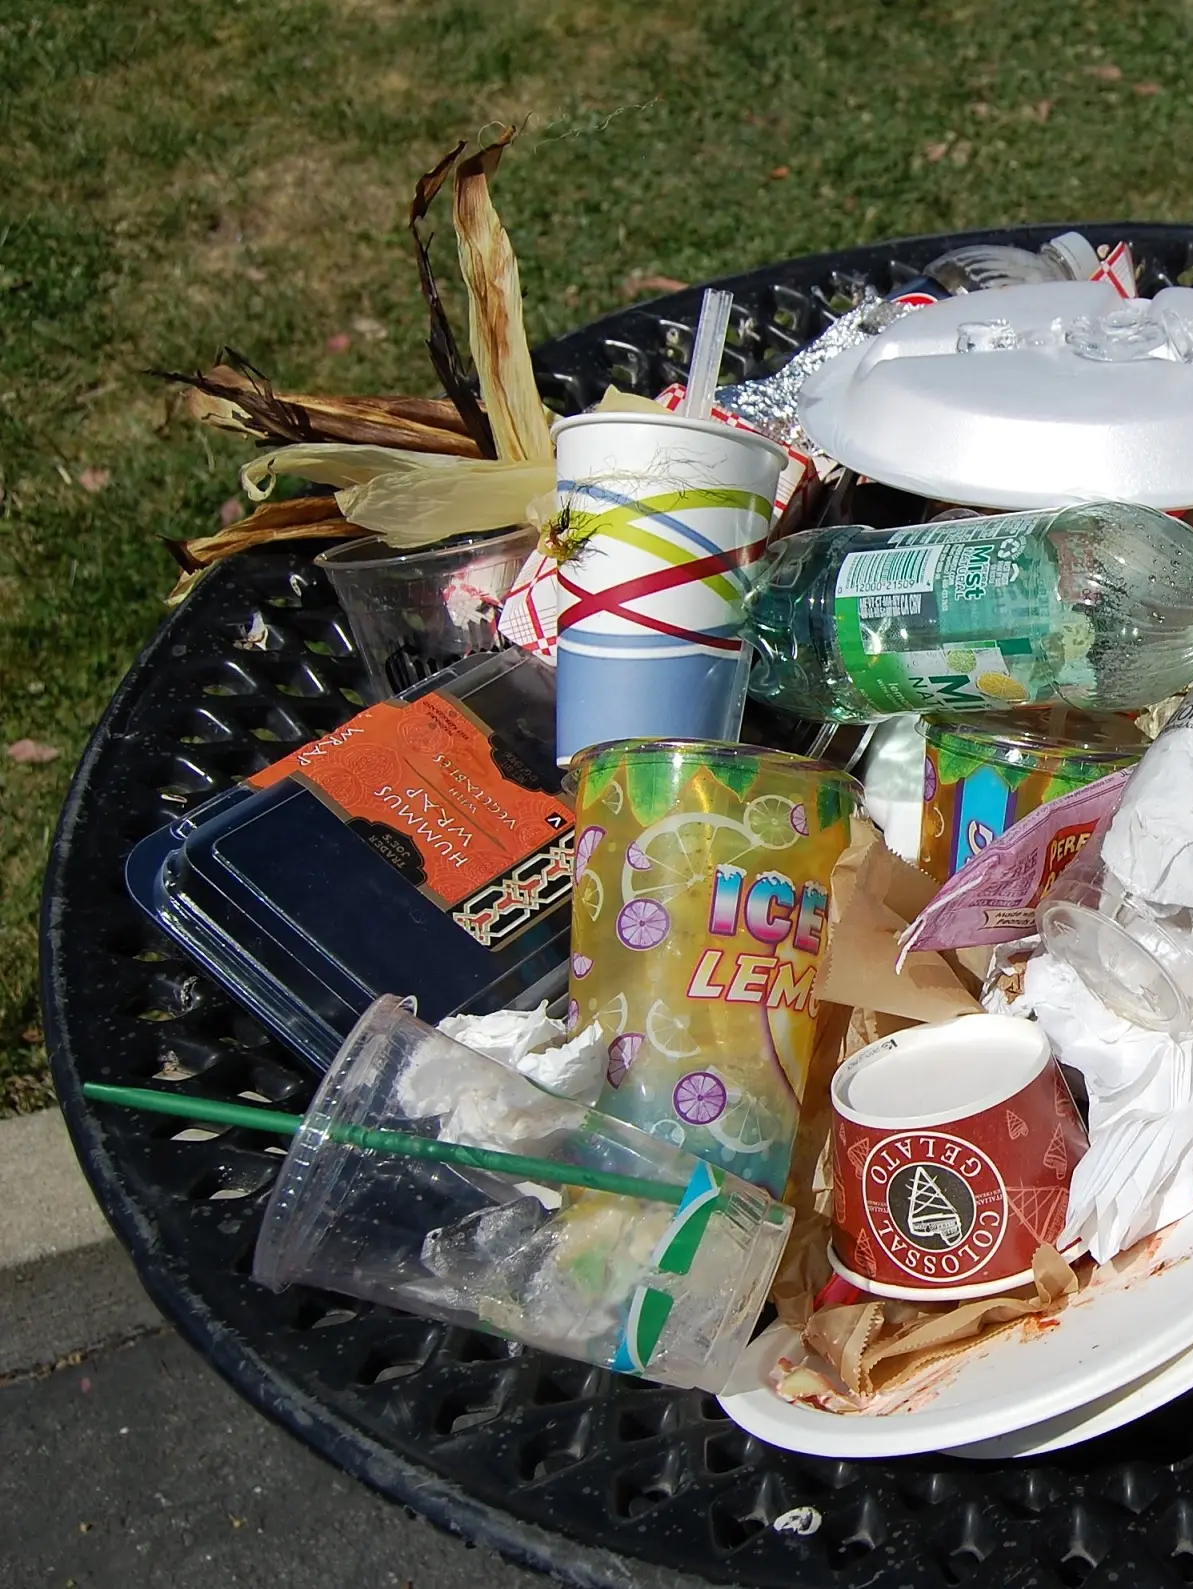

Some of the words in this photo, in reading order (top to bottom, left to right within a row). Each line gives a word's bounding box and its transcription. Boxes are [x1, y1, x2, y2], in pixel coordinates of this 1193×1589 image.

[855, 582, 882, 592] 12000
[885, 579, 915, 589] 21509
[955, 547, 972, 599] NATURAL
[964, 545, 993, 599] Mist
[296, 722, 365, 766] WRAP
[402, 787, 473, 848] WRAP
[430, 753, 514, 830] VEGETABLES
[367, 834, 405, 868] TRADER
[372, 785, 469, 868] HUMMUS
[381, 833, 410, 857] JOE'S
[709, 864, 828, 955] ICE
[871, 1138, 982, 1185] GELATO
[879, 1211, 1001, 1274] COLOSSAL
